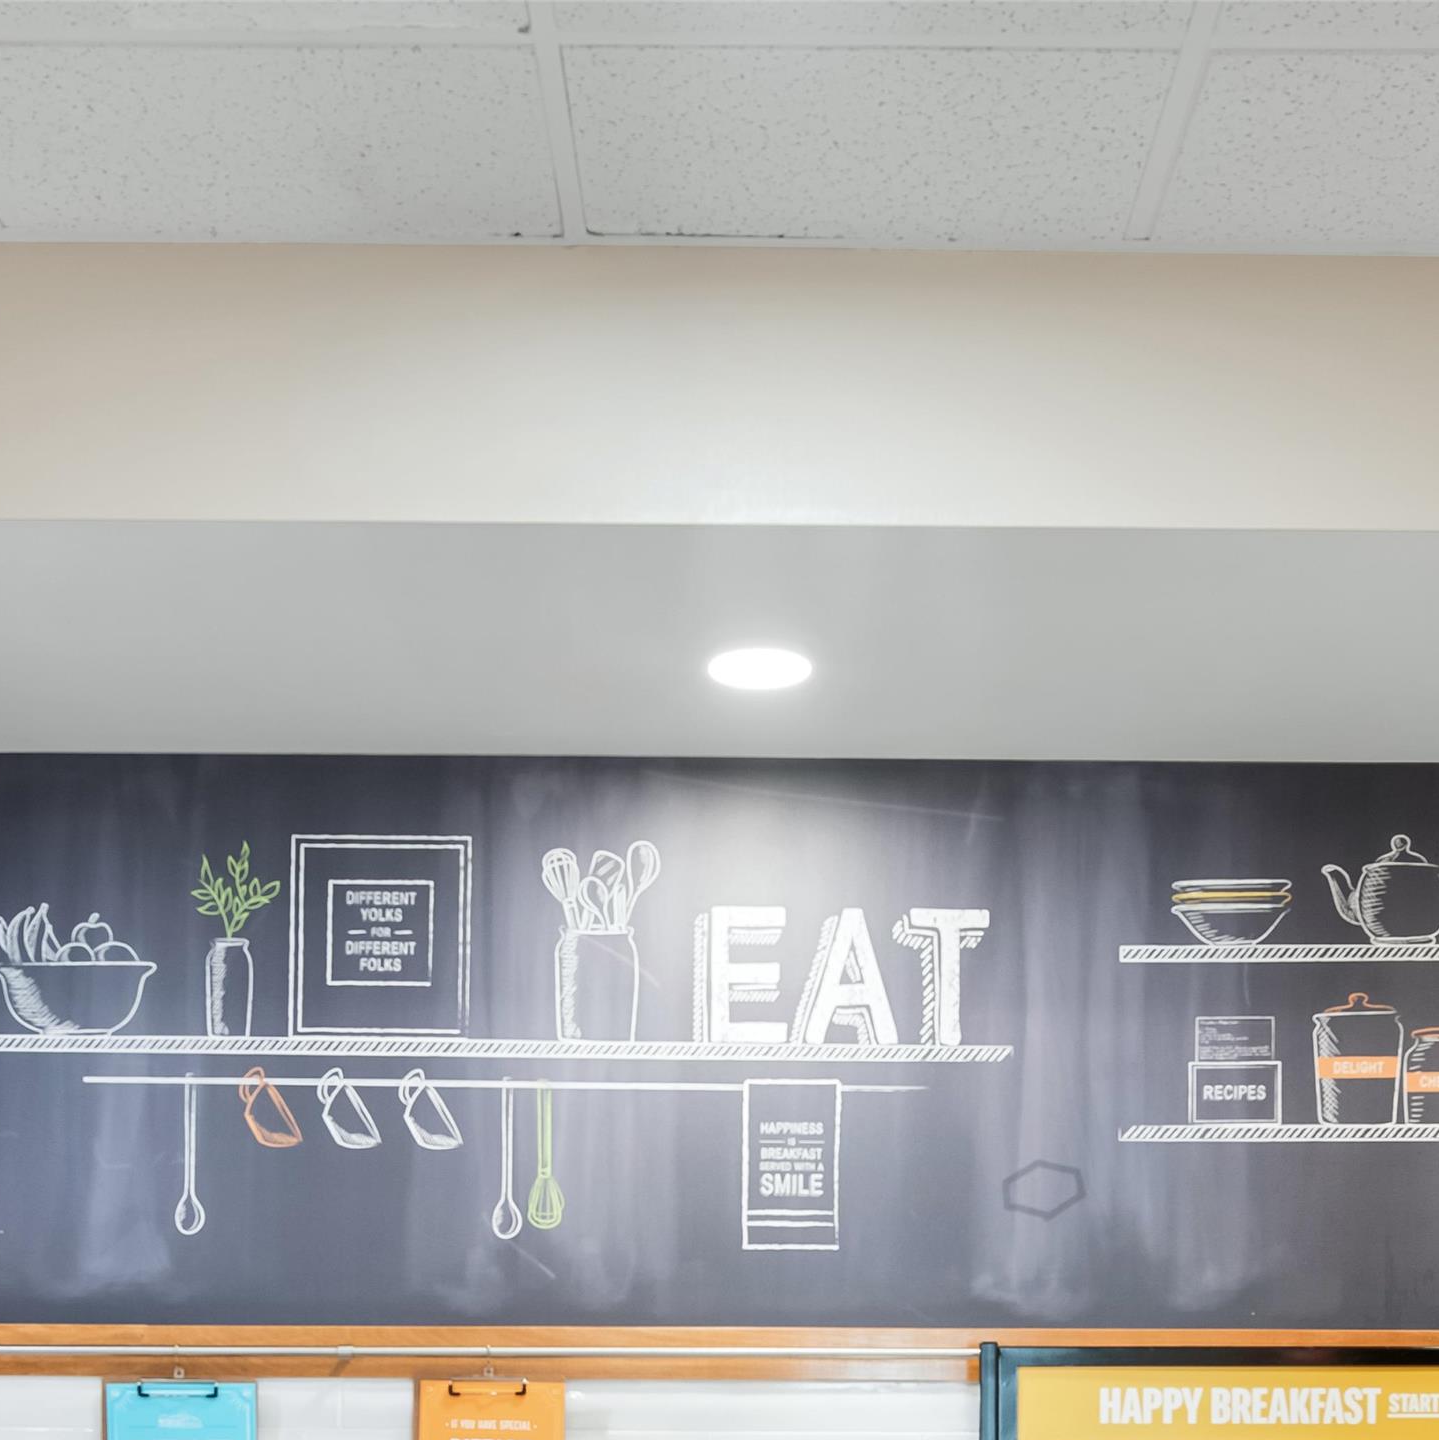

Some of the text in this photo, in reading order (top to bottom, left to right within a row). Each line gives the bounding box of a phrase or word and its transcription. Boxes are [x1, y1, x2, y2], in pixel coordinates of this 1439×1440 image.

[345, 890, 417, 905] DIFFERENT
[360, 907, 403, 922] YOLKS
[370, 926, 391, 937] FOR
[345, 940, 416, 955] DIFFERENT
[359, 957, 402, 972] FOLKS
[693, 905, 991, 1046] EAT
[1332, 1061, 1385, 1074] DELIGHT
[1203, 1084, 1267, 1100] RECIPES
[760, 1121, 824, 1135] HAPPINESS
[760, 1147, 823, 1160] BREAKFAST
[759, 1161, 824, 1171] SERVED WITH A
[760, 1173, 824, 1197] SMILE
[1098, 1387, 1203, 1425] HAPPY
[1210, 1387, 1382, 1425] BREAKFAST
[499, 1420, 531, 1431] SPECIAL
